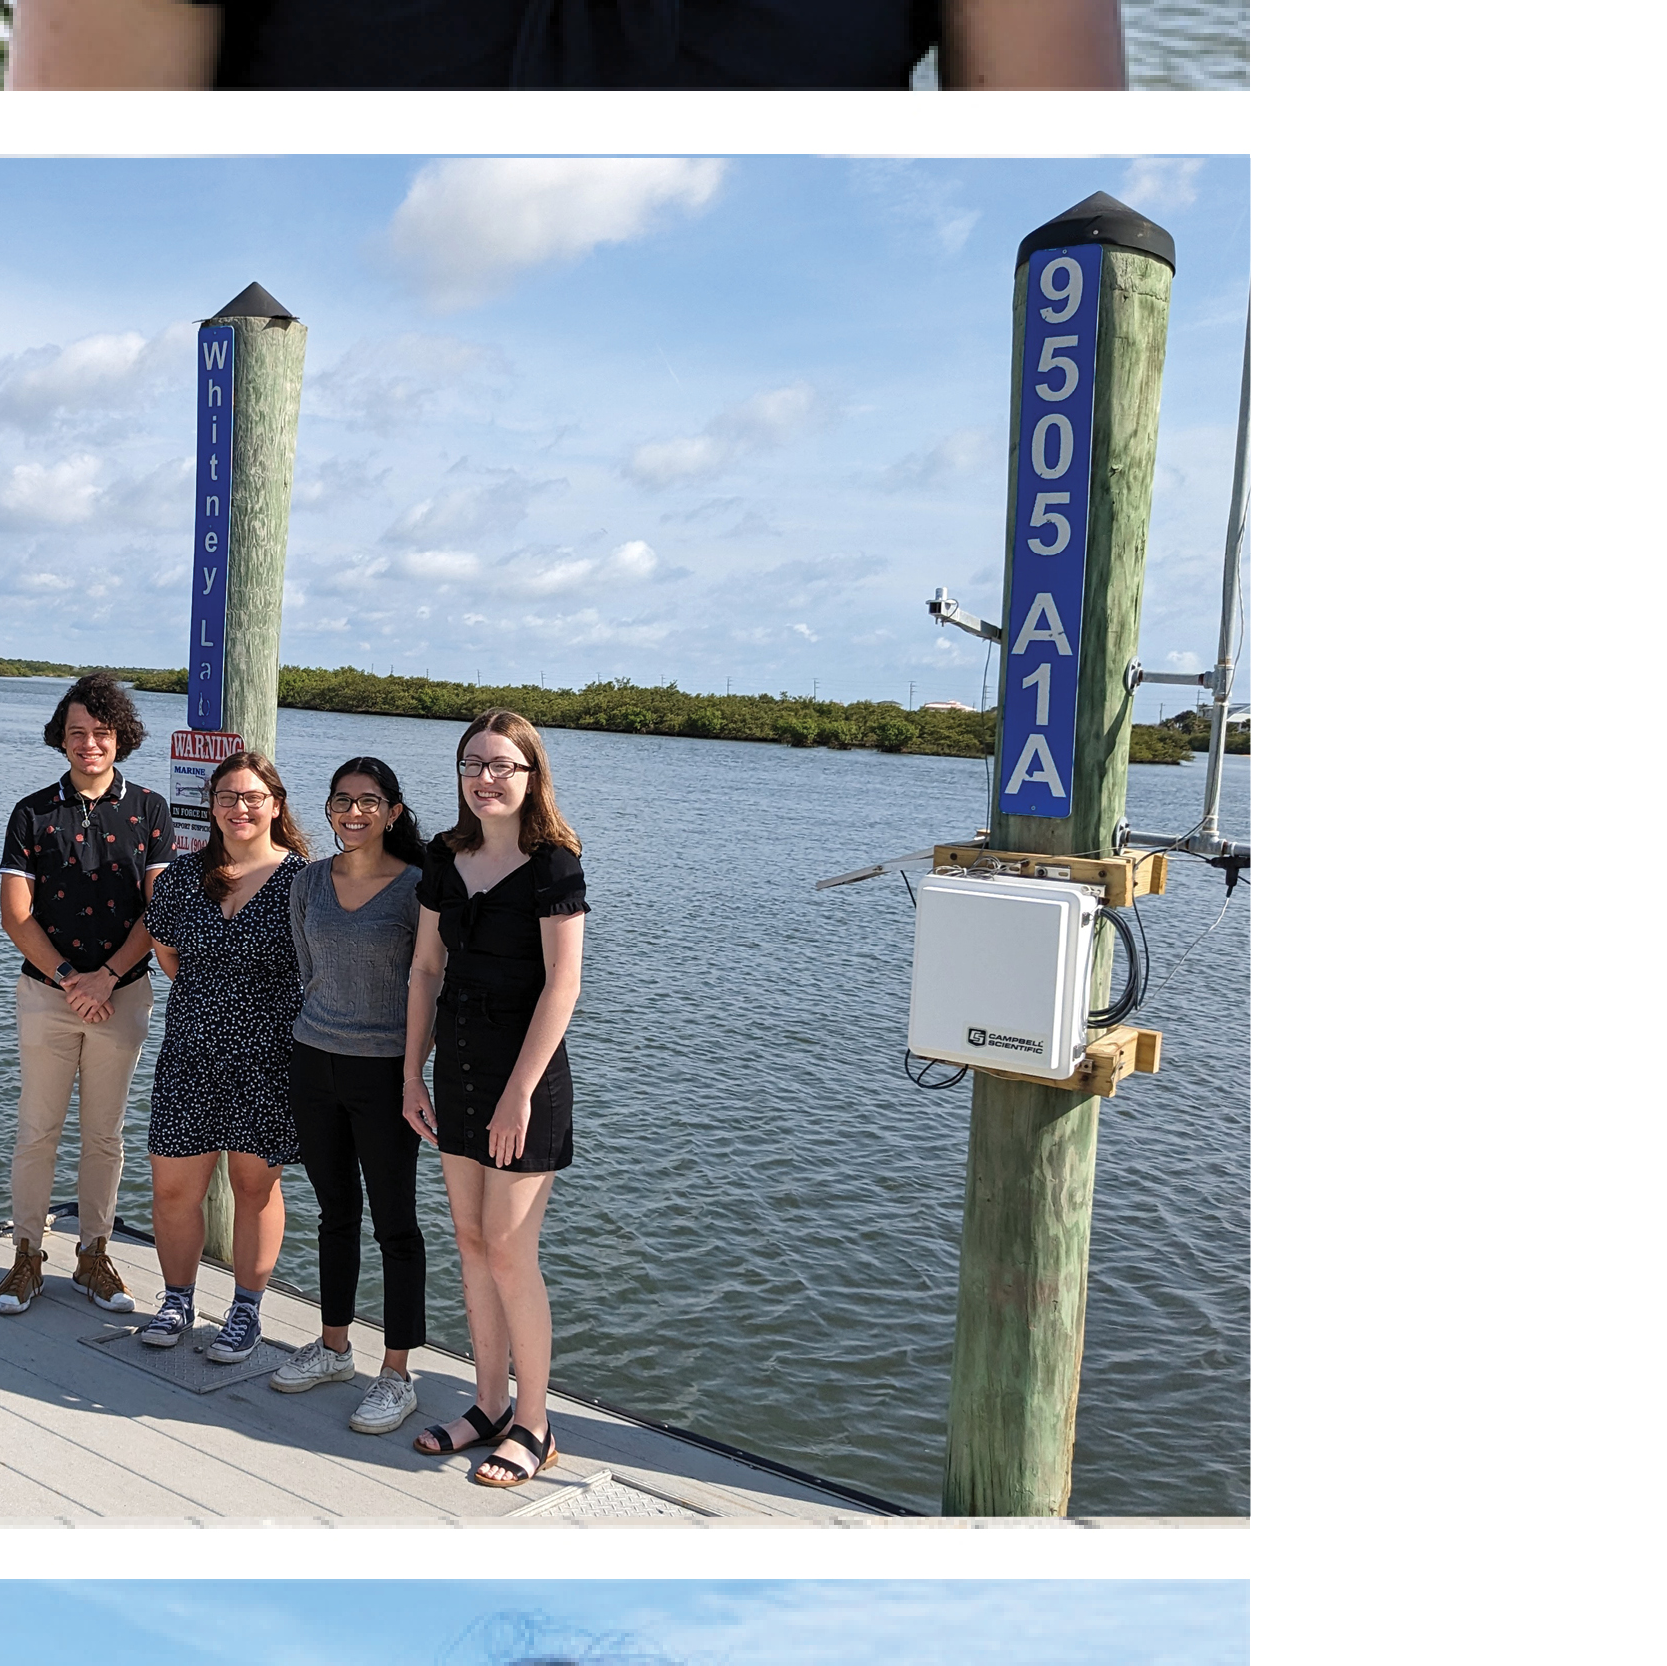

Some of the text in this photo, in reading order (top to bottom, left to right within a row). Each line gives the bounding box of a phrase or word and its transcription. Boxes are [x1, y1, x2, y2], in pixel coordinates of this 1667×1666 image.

[202, 340, 228, 595] Whitney
[1004, 256, 1083, 797] 9505 A1A
[173, 733, 242, 760] WARNING
[174, 766, 206, 776] MARINE
[173, 807, 208, 819] IN FORCE IN
[988, 1033, 1044, 1048] CAMPBELL
[988, 1039, 1044, 1054] SCIENTIFIC
